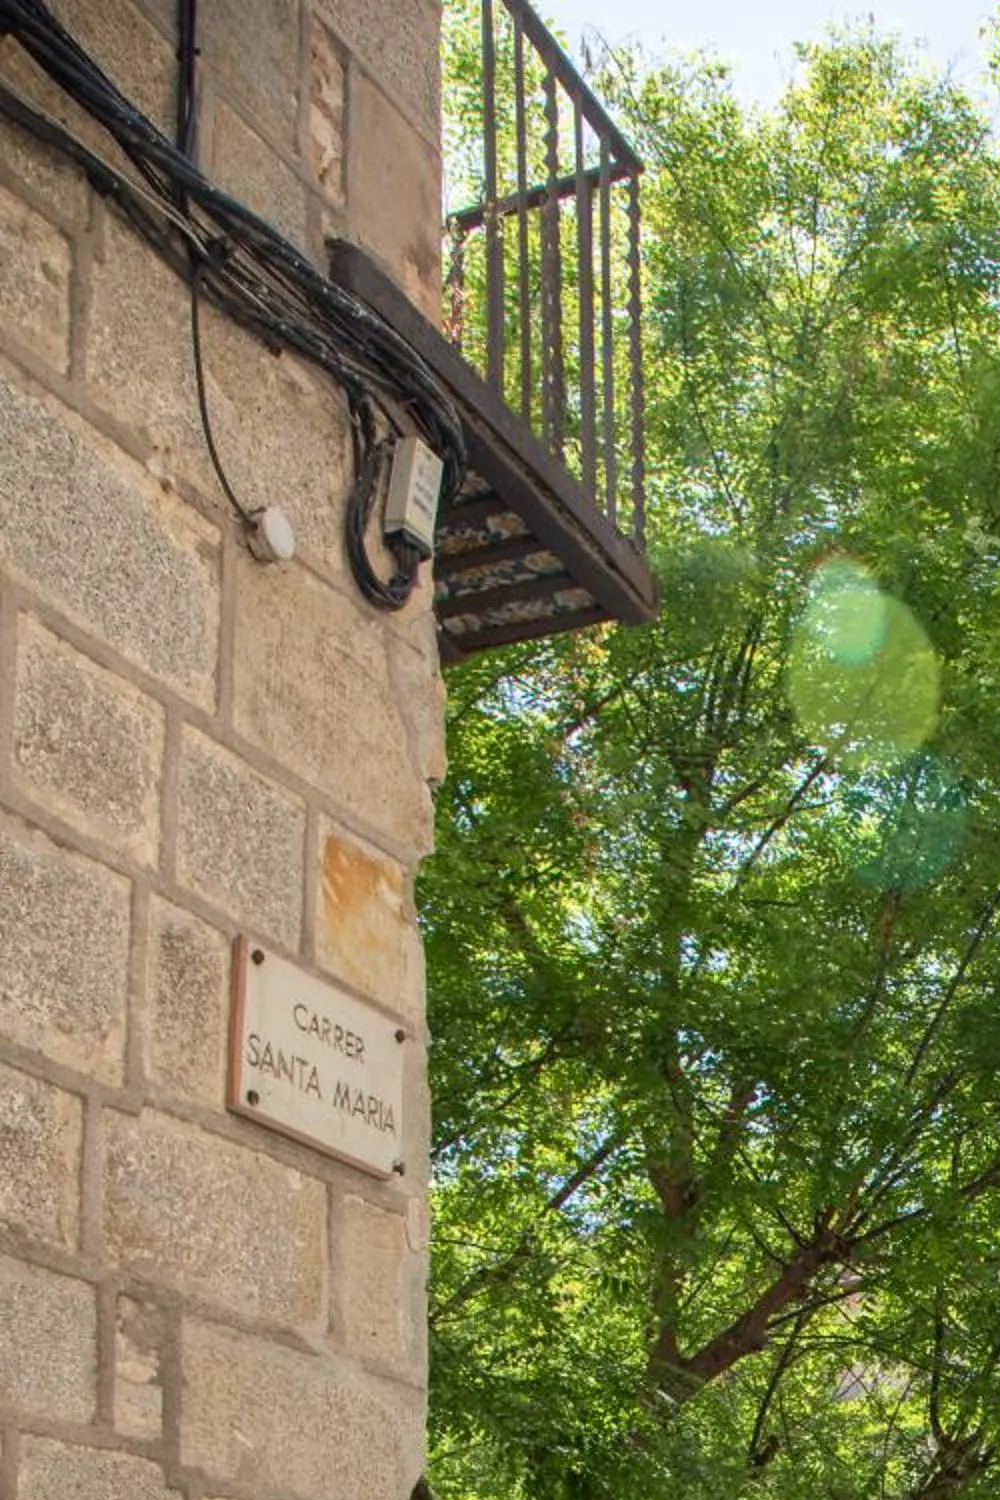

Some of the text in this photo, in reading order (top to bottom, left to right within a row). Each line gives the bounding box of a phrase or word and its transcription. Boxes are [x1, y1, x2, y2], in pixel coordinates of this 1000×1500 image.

[293, 1002, 365, 1064] CARRER
[247, 1033, 396, 1137] SANTA MARIA
